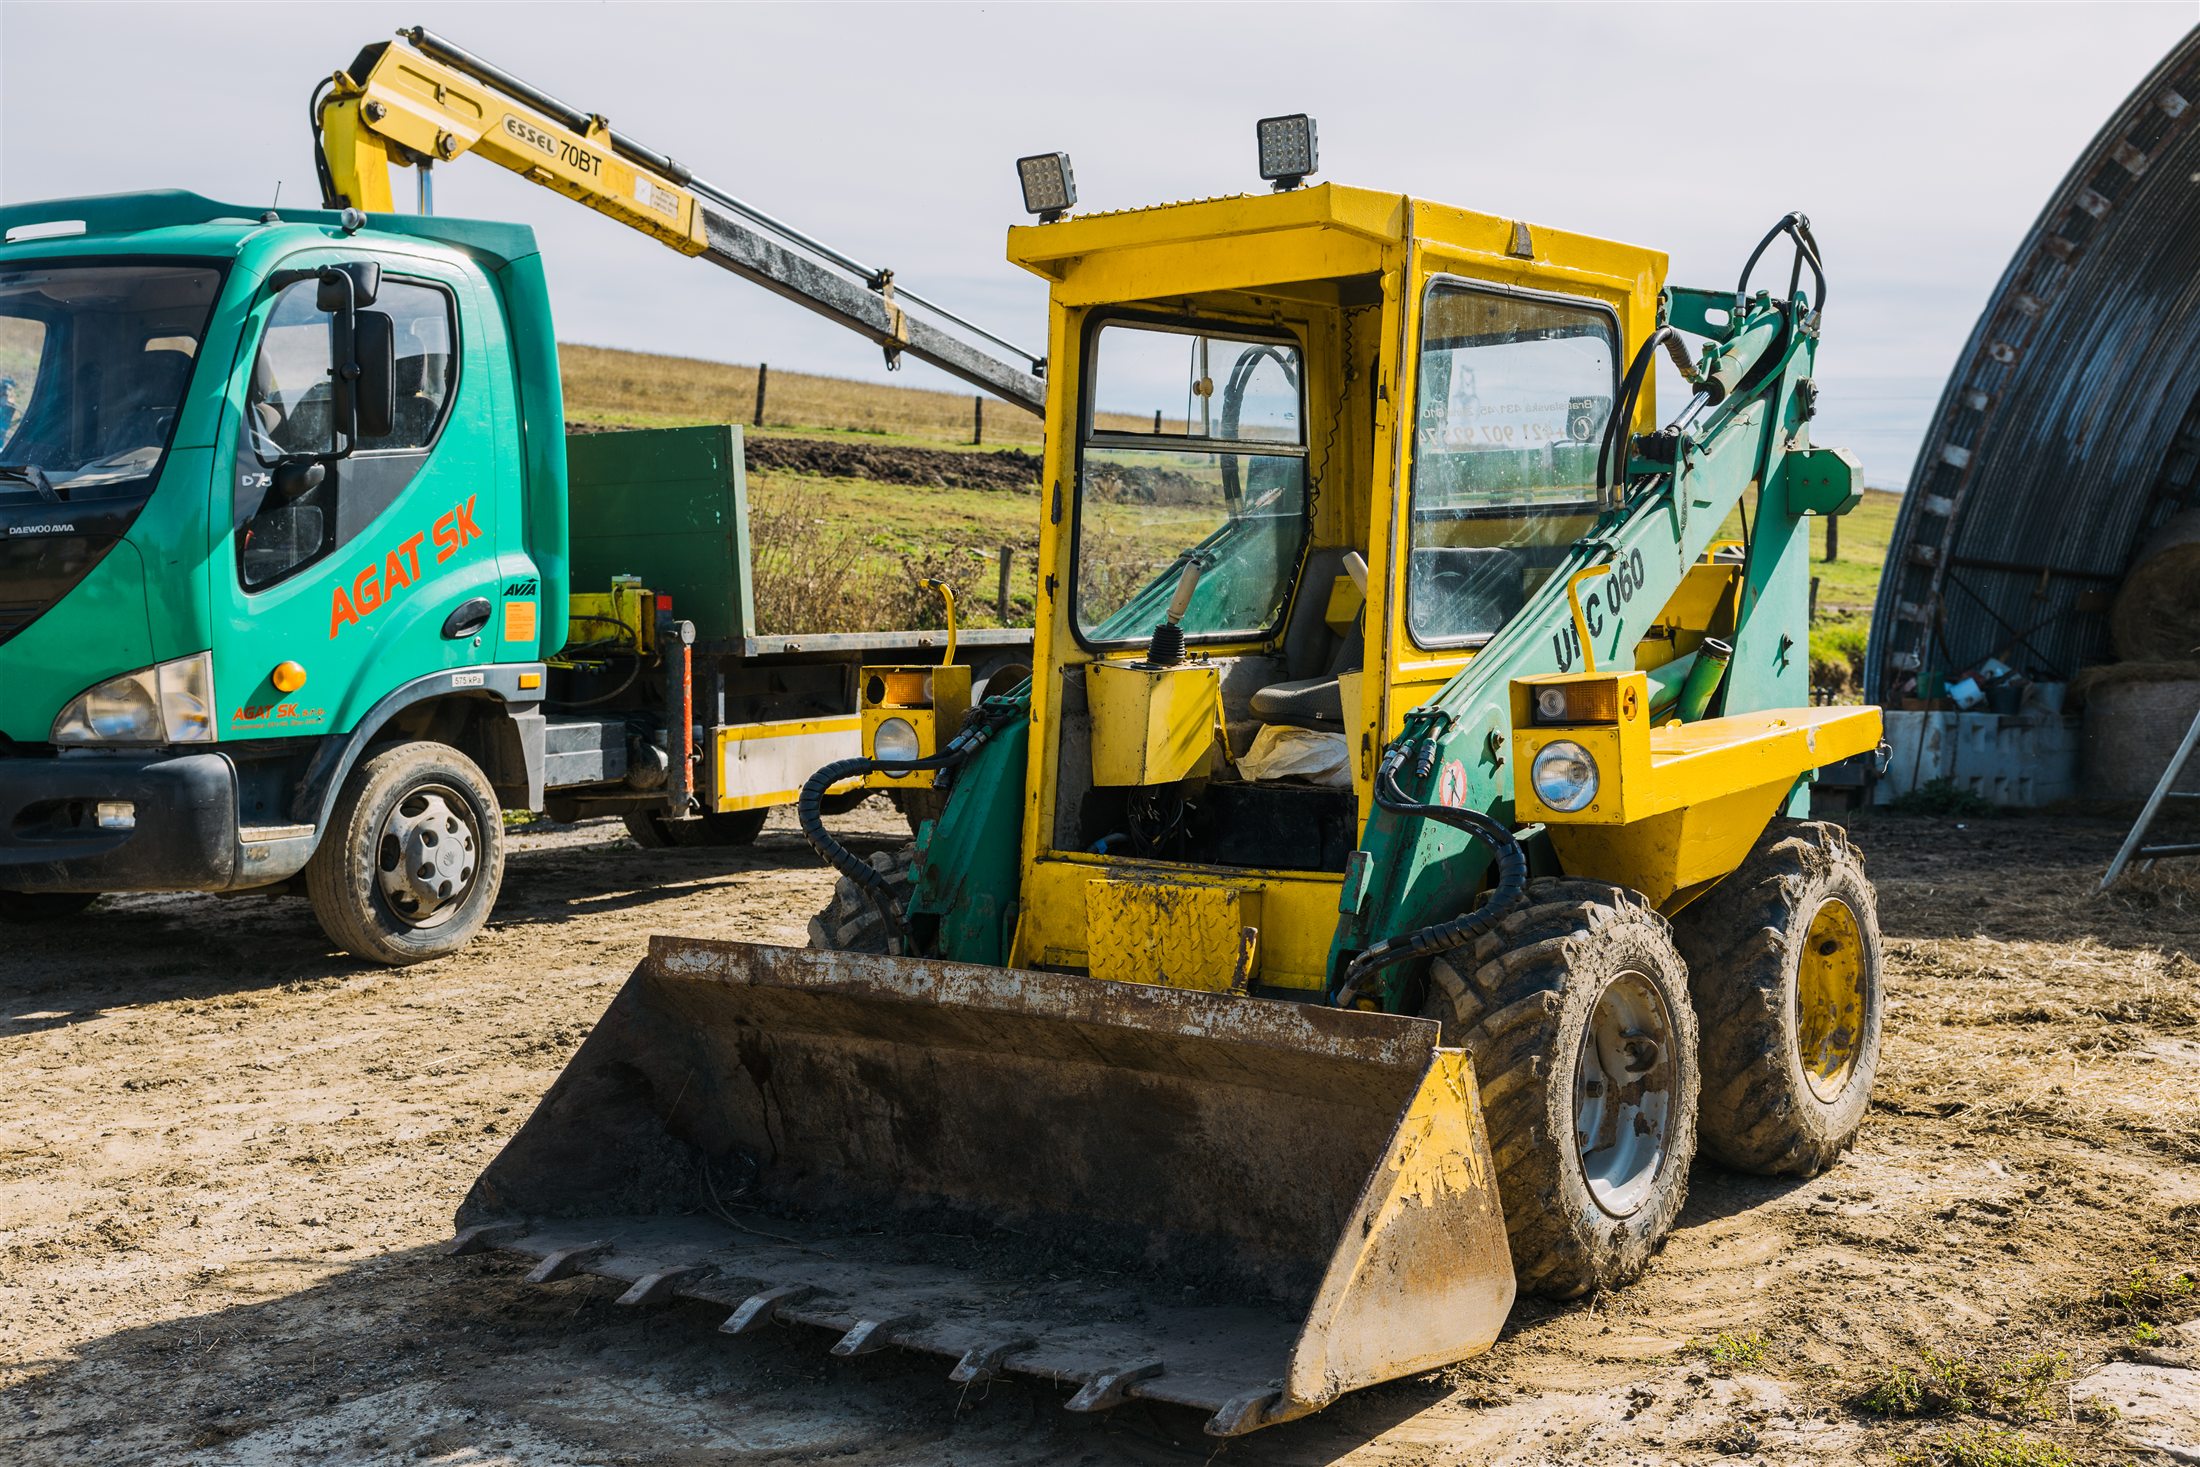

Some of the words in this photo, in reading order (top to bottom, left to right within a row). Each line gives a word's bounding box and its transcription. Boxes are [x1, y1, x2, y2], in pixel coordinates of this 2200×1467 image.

[507, 119, 554, 154] ESSEL
[560, 140, 602, 176] 70BT
[9, 525, 51, 534] DAEWOO
[52, 524, 75, 532] AVIA
[329, 530, 425, 641] AGAT
[432, 493, 483, 565] SK
[503, 582, 537, 596] AVIA
[1607, 548, 1644, 616] 060
[454, 676, 467, 685] 575
[468, 675, 482, 684] kPa
[232, 704, 274, 721] AGAT
